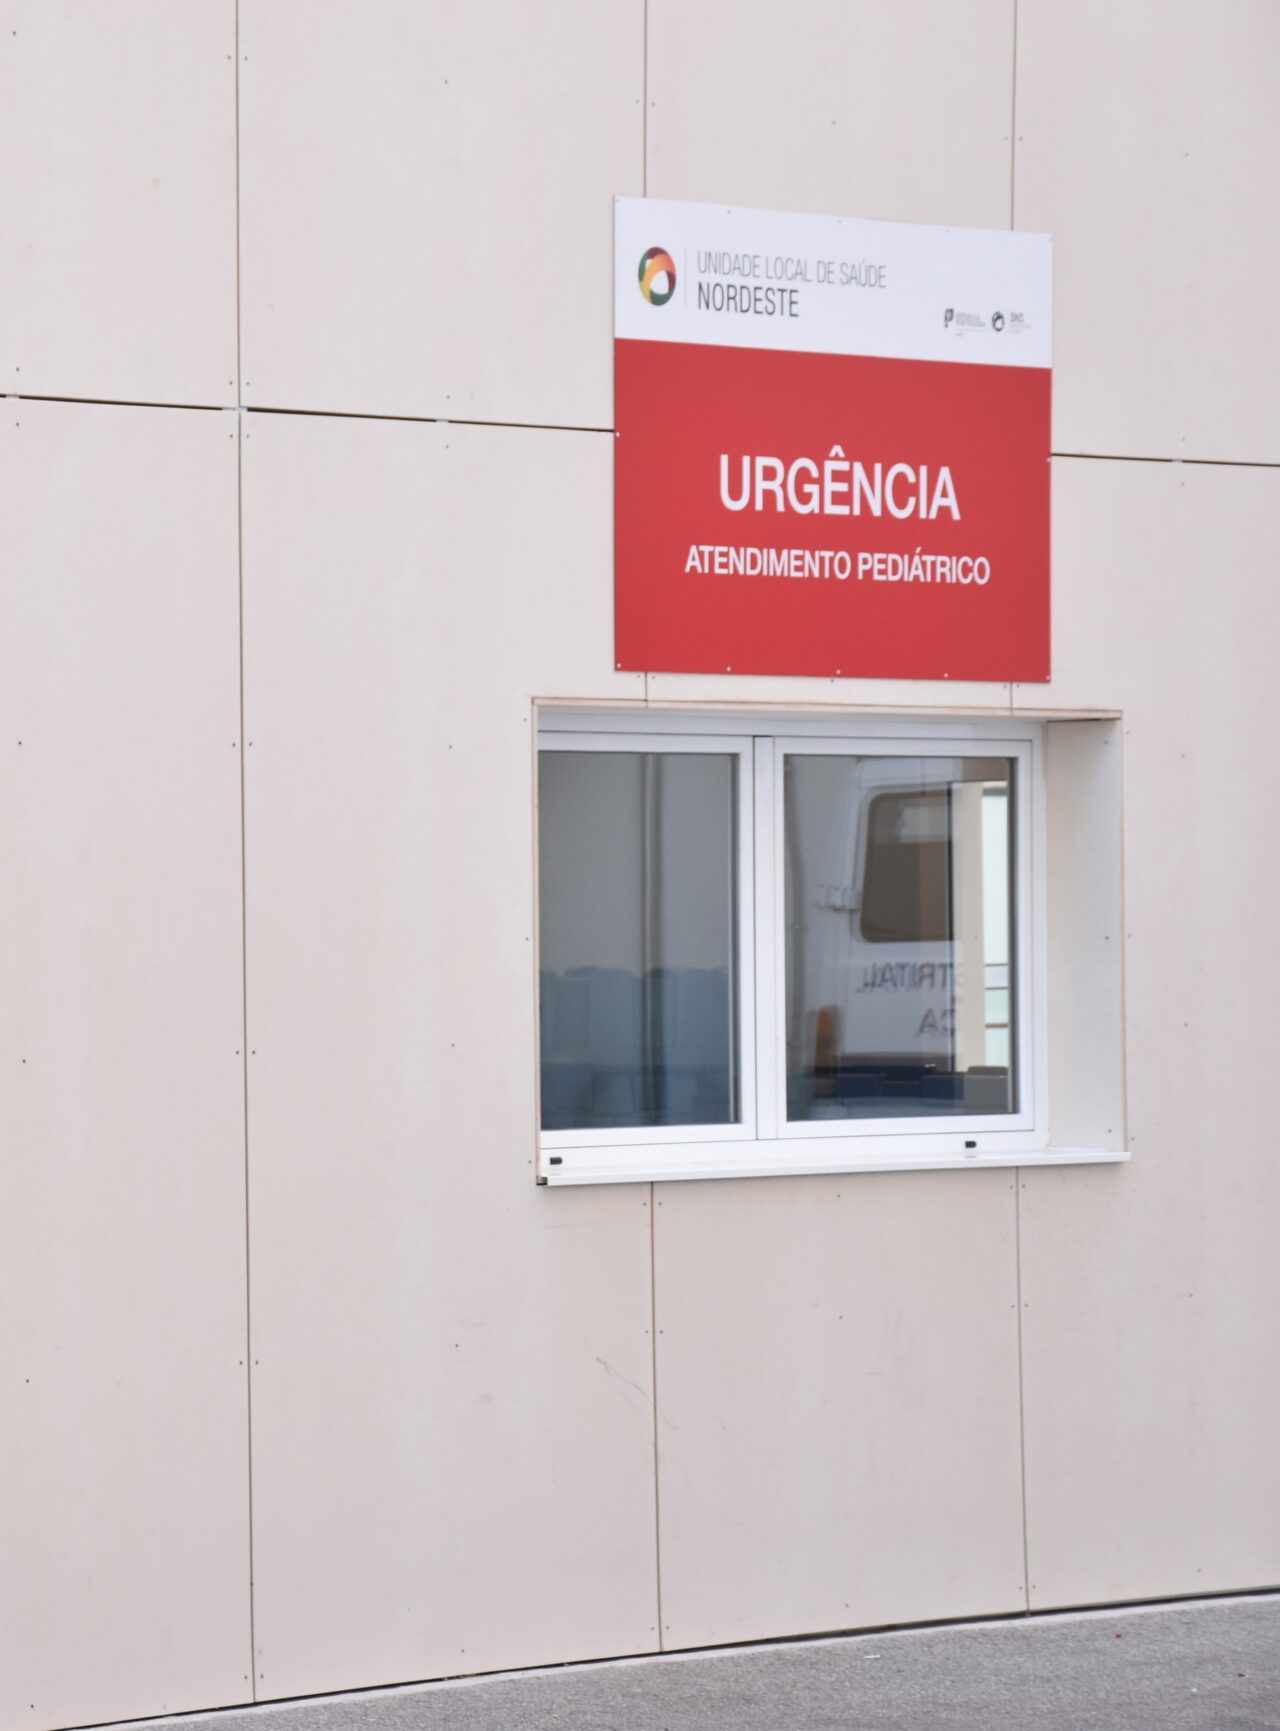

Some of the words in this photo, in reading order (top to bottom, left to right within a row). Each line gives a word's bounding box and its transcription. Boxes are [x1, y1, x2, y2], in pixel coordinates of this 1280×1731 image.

[697, 250, 761, 278] UNIDADE
[765, 256, 812, 282] LOCAL
[817, 260, 836, 285] DE
[839, 259, 887, 289] SAÚDE
[698, 281, 799, 317] NORDESTE
[720, 445, 961, 521] URGÊNCIA
[684, 544, 851, 580] ATENDIMENTO
[857, 547, 991, 585] PEDIÁTRICO
